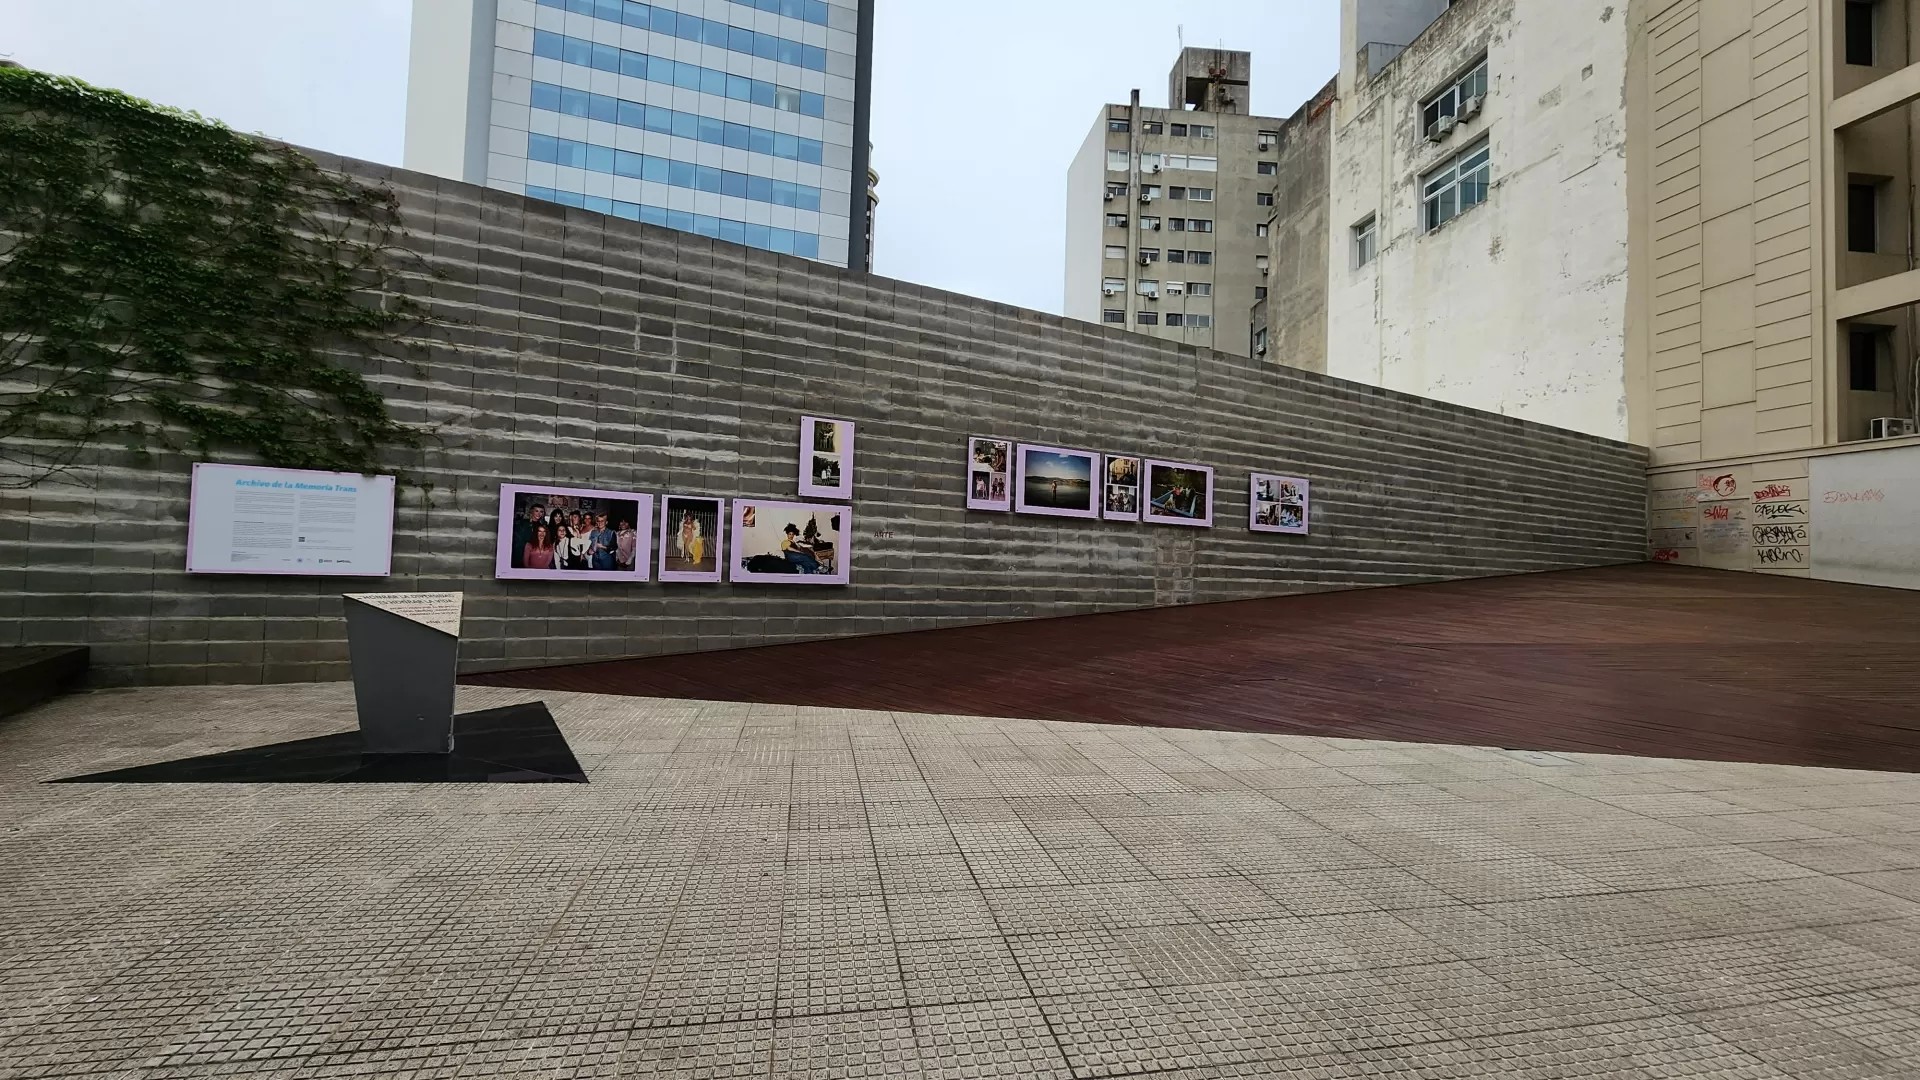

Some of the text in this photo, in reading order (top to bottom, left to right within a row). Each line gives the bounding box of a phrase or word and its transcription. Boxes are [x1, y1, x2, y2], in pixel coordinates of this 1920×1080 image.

[235, 479, 357, 493] Archivo de la Memoria Trans
